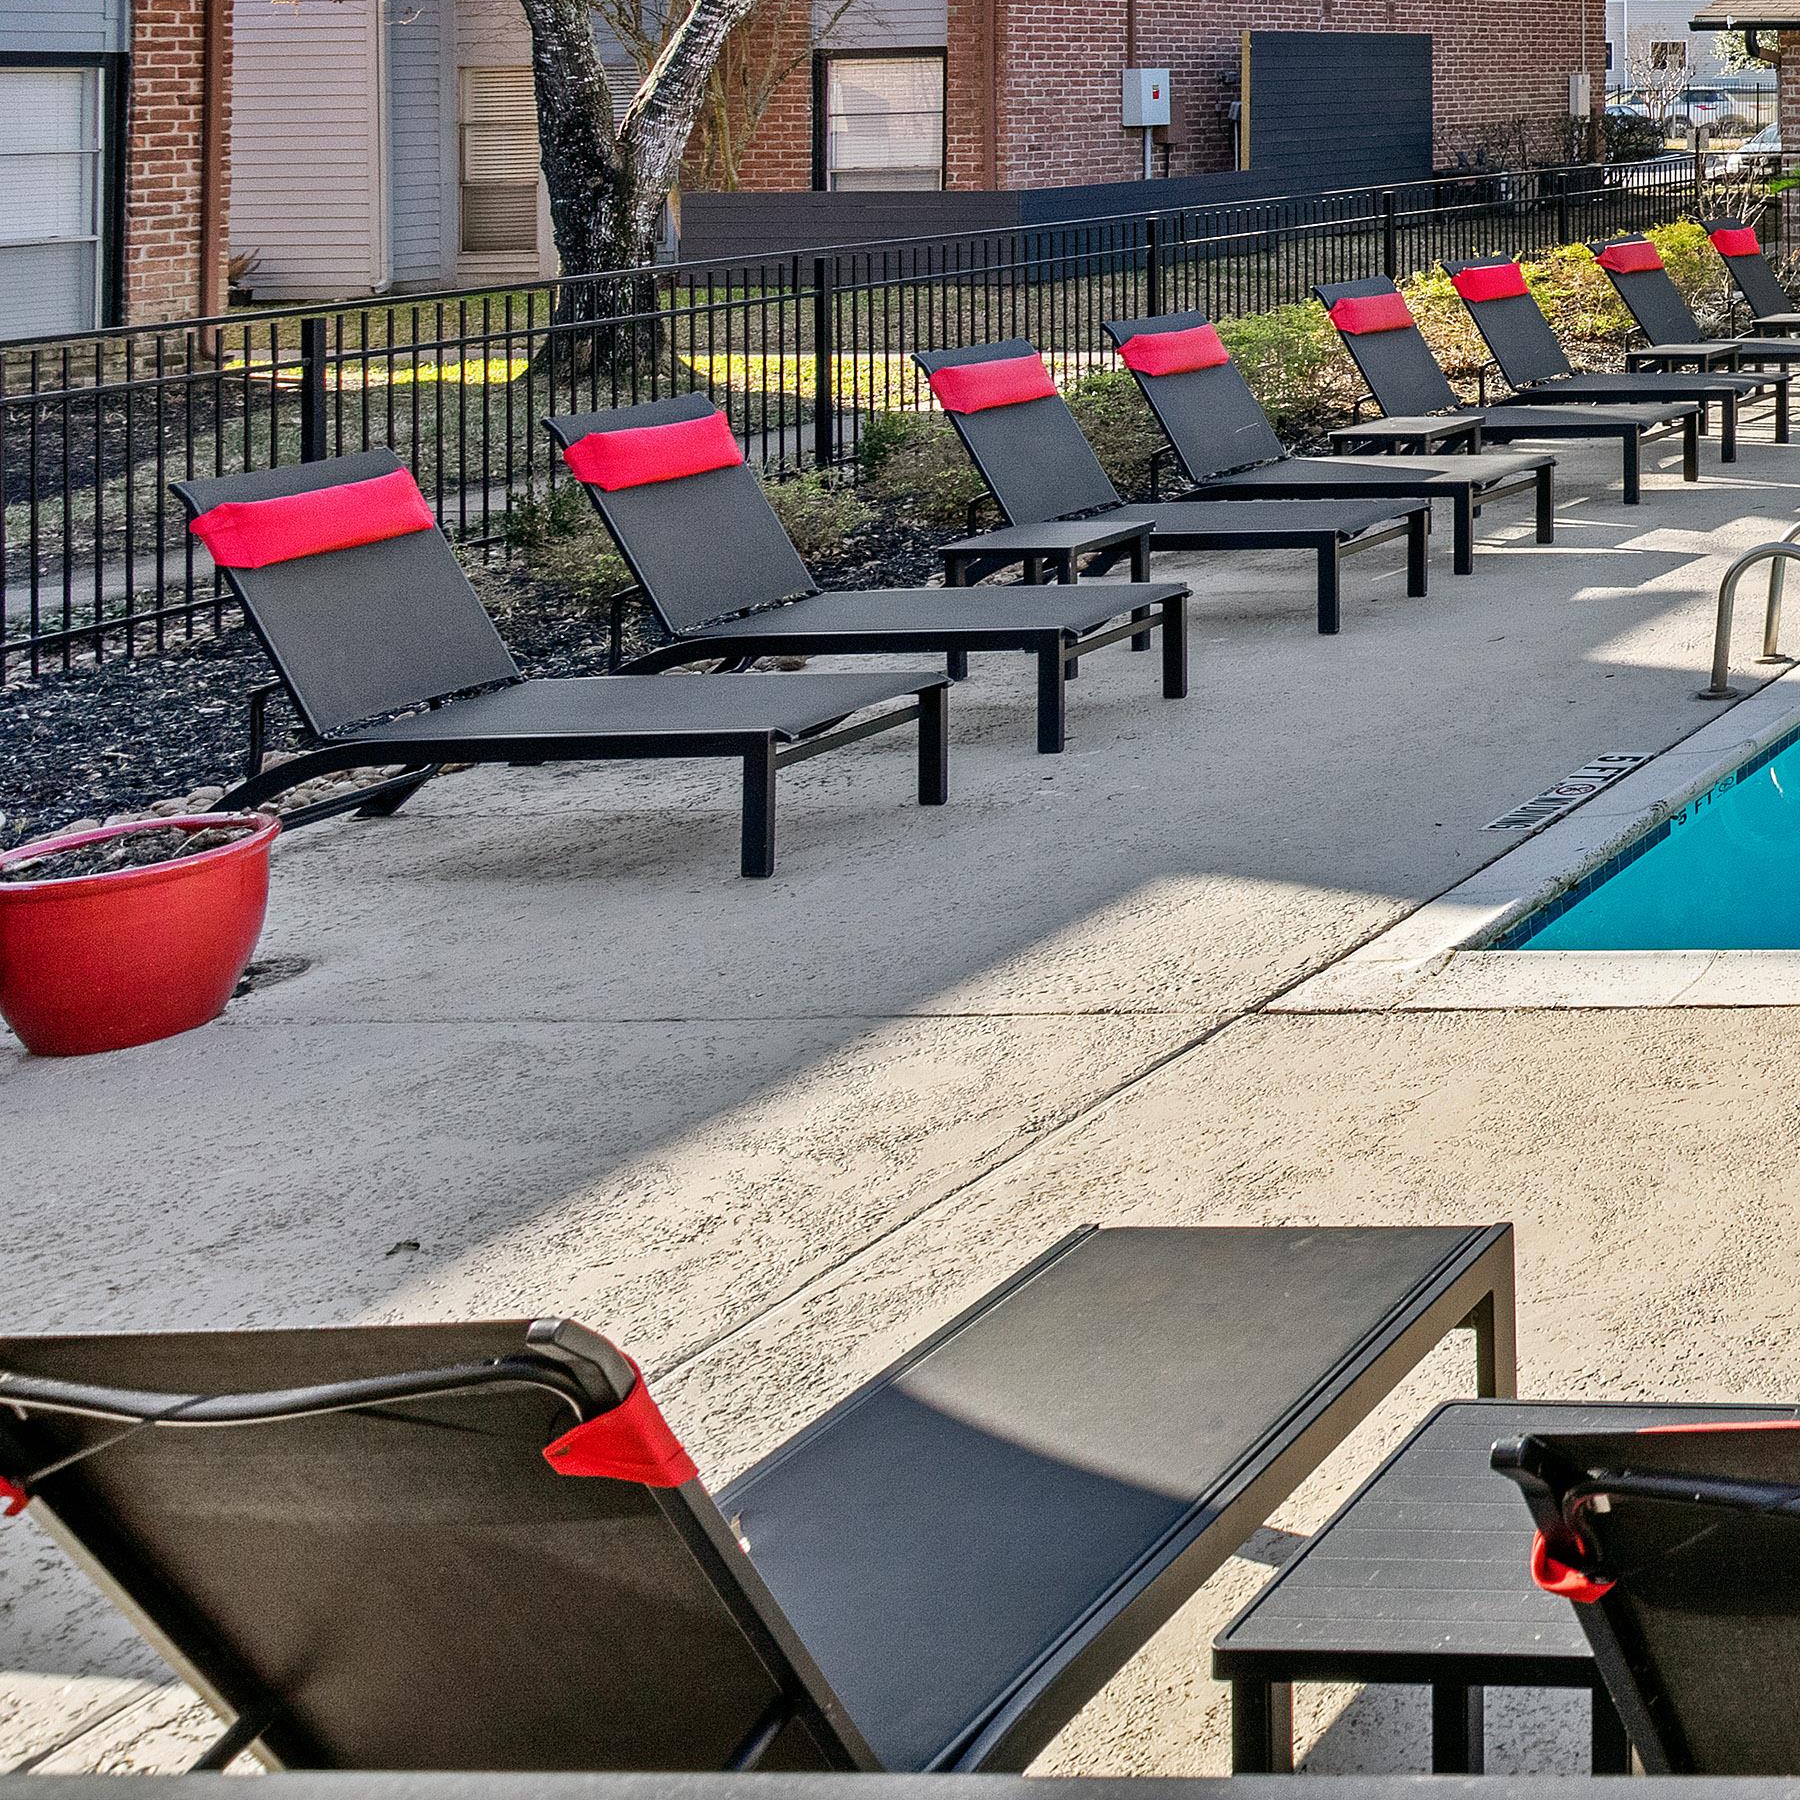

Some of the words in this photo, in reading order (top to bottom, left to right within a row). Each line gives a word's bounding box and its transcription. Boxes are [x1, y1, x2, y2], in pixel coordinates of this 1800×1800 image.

[1597, 755, 1644, 763] 5
[1568, 766, 1630, 782] FT
[1677, 808, 1688, 826] 5
[1694, 788, 1715, 816] FT
